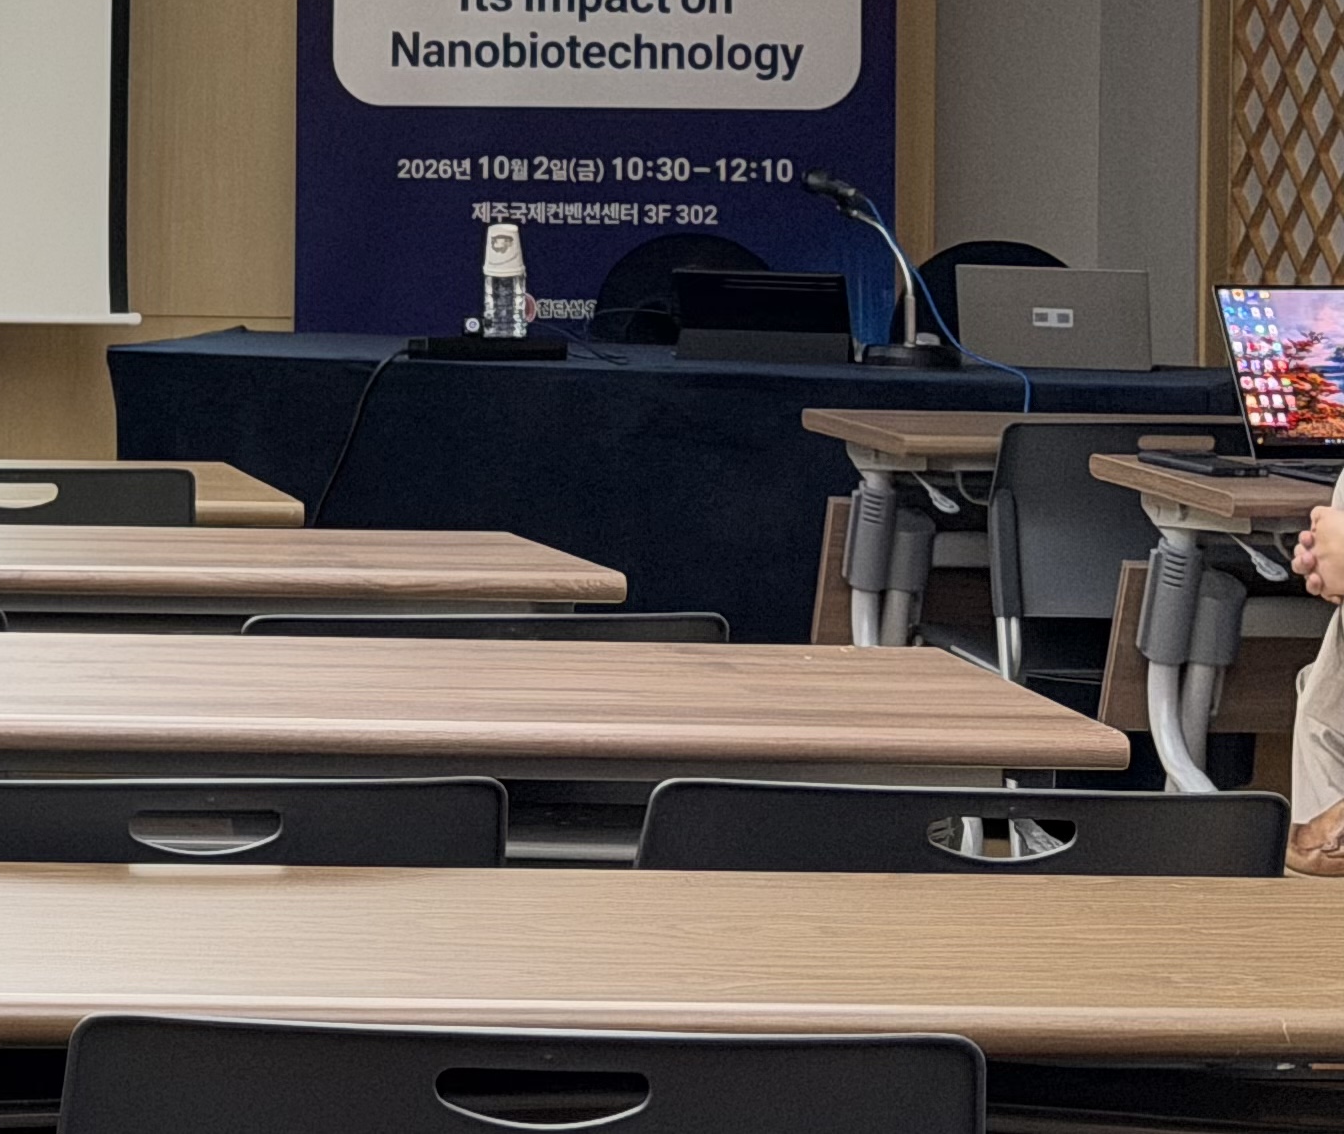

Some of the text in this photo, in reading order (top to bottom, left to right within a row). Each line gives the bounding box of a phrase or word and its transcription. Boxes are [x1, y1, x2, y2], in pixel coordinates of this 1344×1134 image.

[391, 31, 804, 81] Nanobiotechnology
[397, 157, 471, 181] 2026년
[477, 156, 528, 181] 10월
[534, 157, 604, 183] 2일(금)
[471, 202, 718, 226] 제주국제컨벤션센터 3F 302
